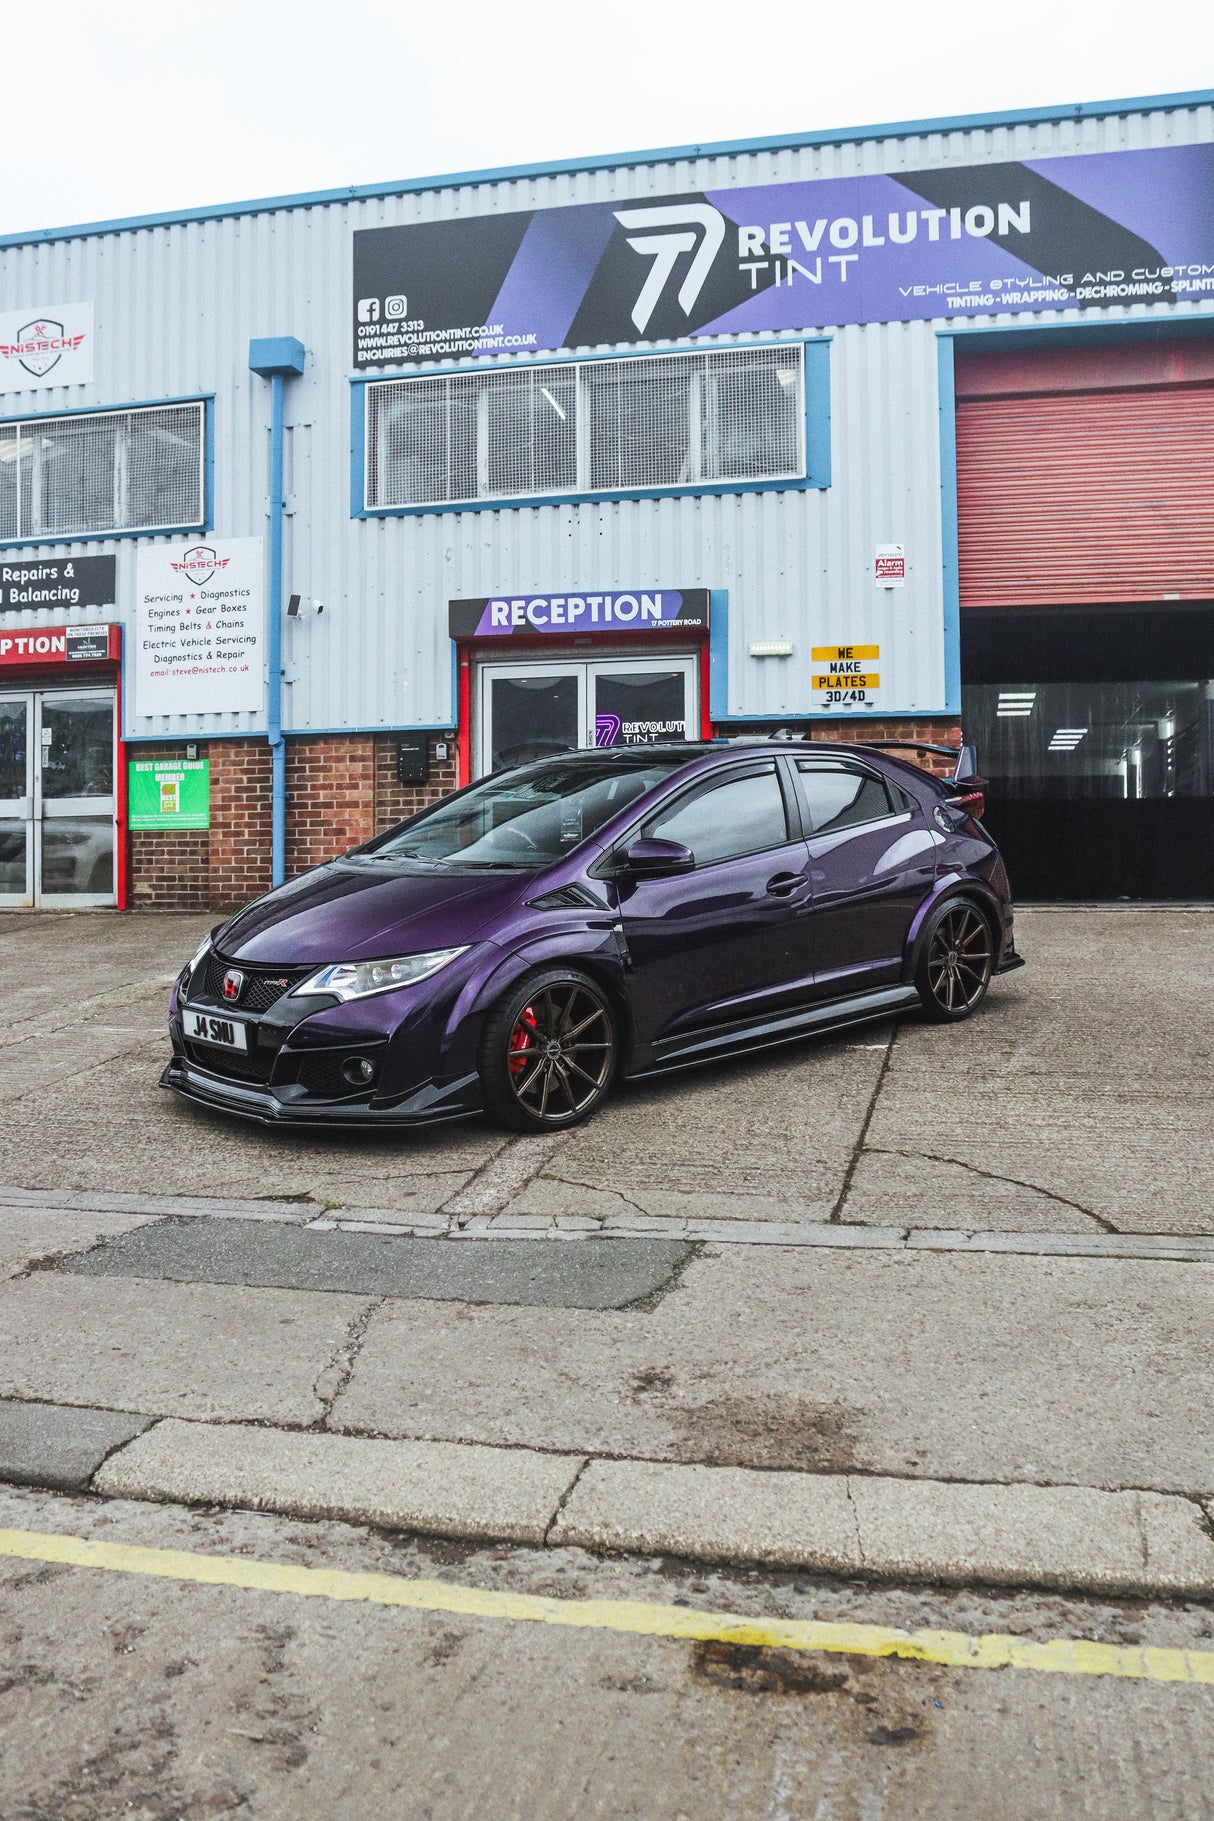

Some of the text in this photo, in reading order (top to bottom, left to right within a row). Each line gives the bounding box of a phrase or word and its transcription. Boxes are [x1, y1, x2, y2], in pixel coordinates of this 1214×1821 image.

[738, 200, 1031, 257] REVOLUTION
[739, 254, 859, 290] TINT
[899, 264, 1214, 297] VEHICLE STYLING AND CUSTOM
[400, 320, 424, 332] 3313
[358, 324, 504, 348] WWW.REVOLUTIONTINT.CO.UK
[358, 334, 537, 361] ENQUIRIES@REVOLUTIONTINT.CO.UK
[877, 559, 903, 567] Alarm
[2, 563, 75, 585] Repairs &
[9, 586, 80, 603] Balancing
[144, 588, 250, 603] Servicing Diagnostics
[148, 604, 247, 619] Engines Gear Boxes
[491, 593, 662, 627] RECEPTION
[148, 620, 245, 634] Timing Belts & Chains
[683, 618, 702, 626] ROAD
[0, 635, 65, 655] PTION
[143, 635, 257, 649] Electric Vehicle Servicing
[153, 650, 245, 664] Diagnostics & Repair
[838, 648, 853, 658] WE
[830, 662, 861, 673] MAKE
[819, 676, 866, 688] PLATES
[826, 690, 865, 702] 3D/4D
[622, 720, 685, 733] REVOLUT
[623, 733, 659, 743] TINT
[136, 761, 204, 772] BEST GARAGE GUIDE
[155, 773, 185, 781] MEMBER
[193, 1015, 208, 1038] J4
